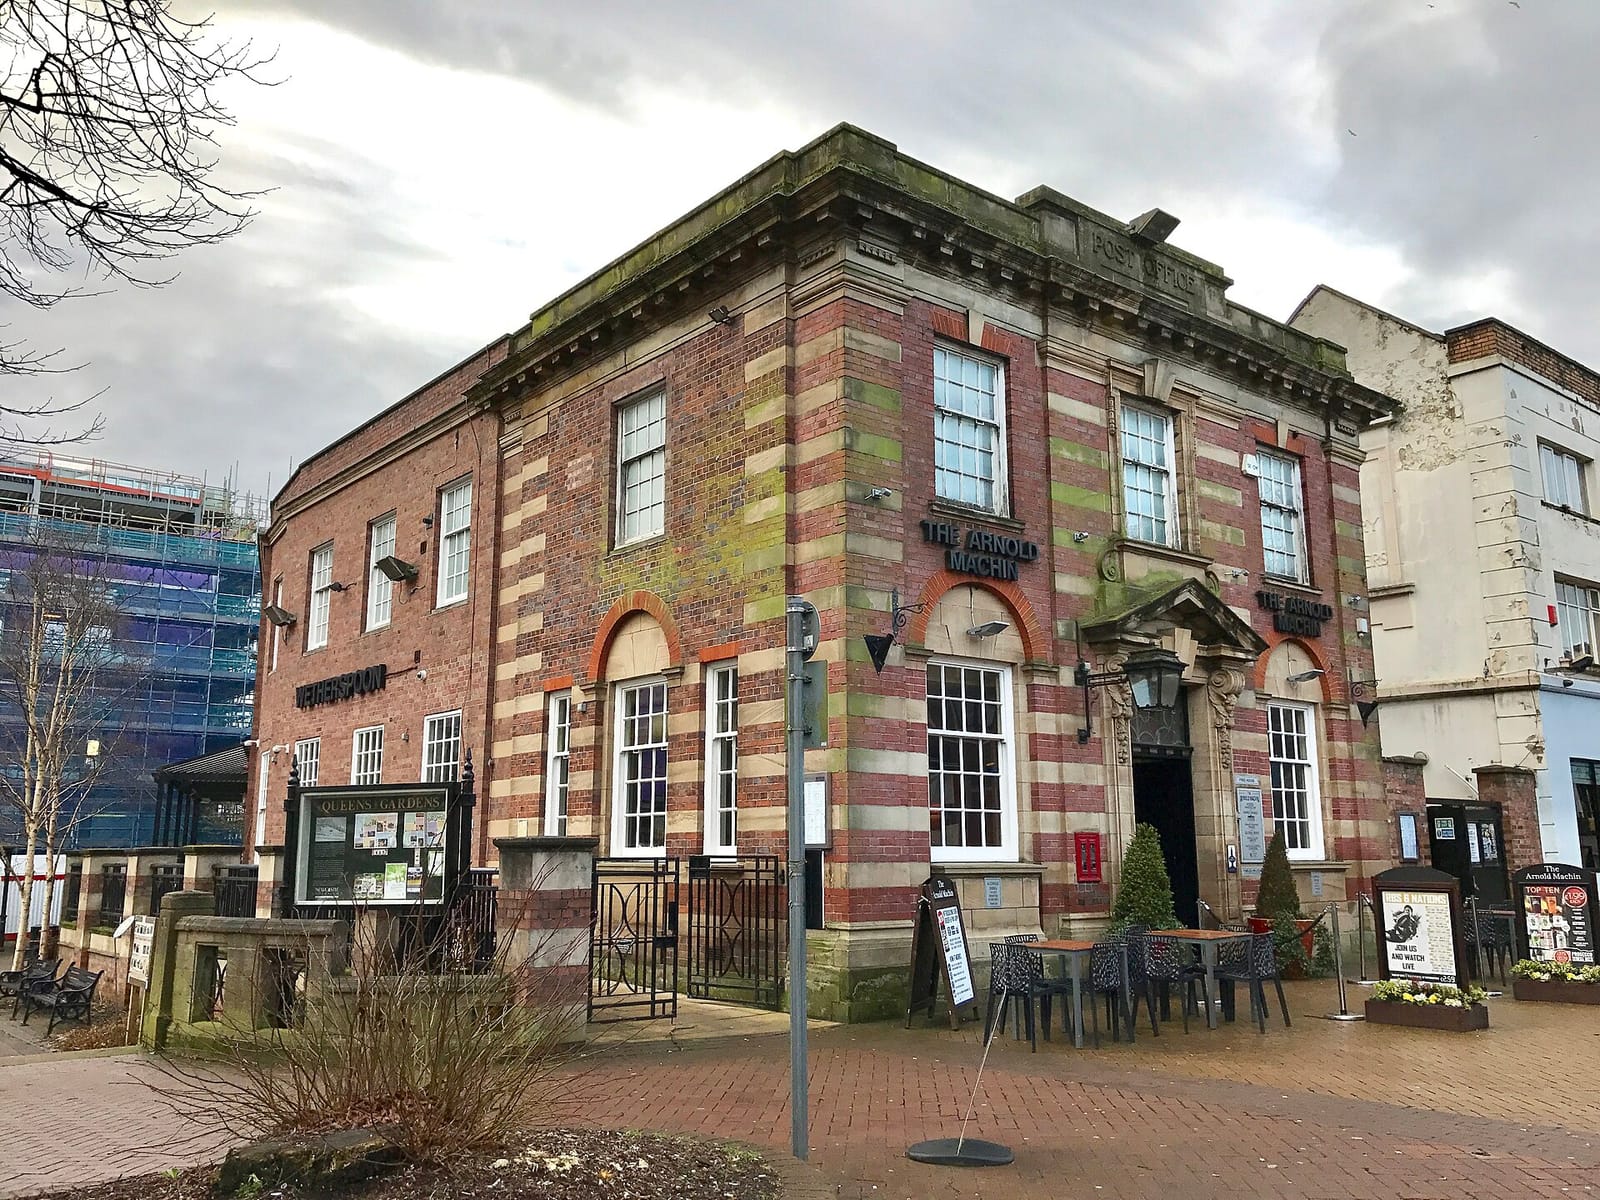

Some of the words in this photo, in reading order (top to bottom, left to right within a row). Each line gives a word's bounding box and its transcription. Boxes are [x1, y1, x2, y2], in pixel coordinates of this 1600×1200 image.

[1092, 232, 1135, 269] POST
[1144, 255, 1195, 295] OFFICE
[921, 520, 961, 547] THE
[966, 529, 1040, 561] ARNOLD
[945, 549, 1018, 581] MACHIN
[1257, 591, 1285, 610] THE
[1285, 597, 1333, 620] ARNOLD
[1274, 613, 1321, 637] MACHIN
[295, 664, 387, 708] WETHERSPOON
[320, 799, 372, 813] QUEENS
[379, 796, 441, 810] GARDENS
[1543, 865, 1560, 873] The
[1543, 886, 1560, 894] TEN
[1410, 893, 1447, 905] NATIONS
[1408, 944, 1417, 952] US
[1402, 962, 1415, 970] LIVE
[1404, 953, 1425, 962] WATCH
